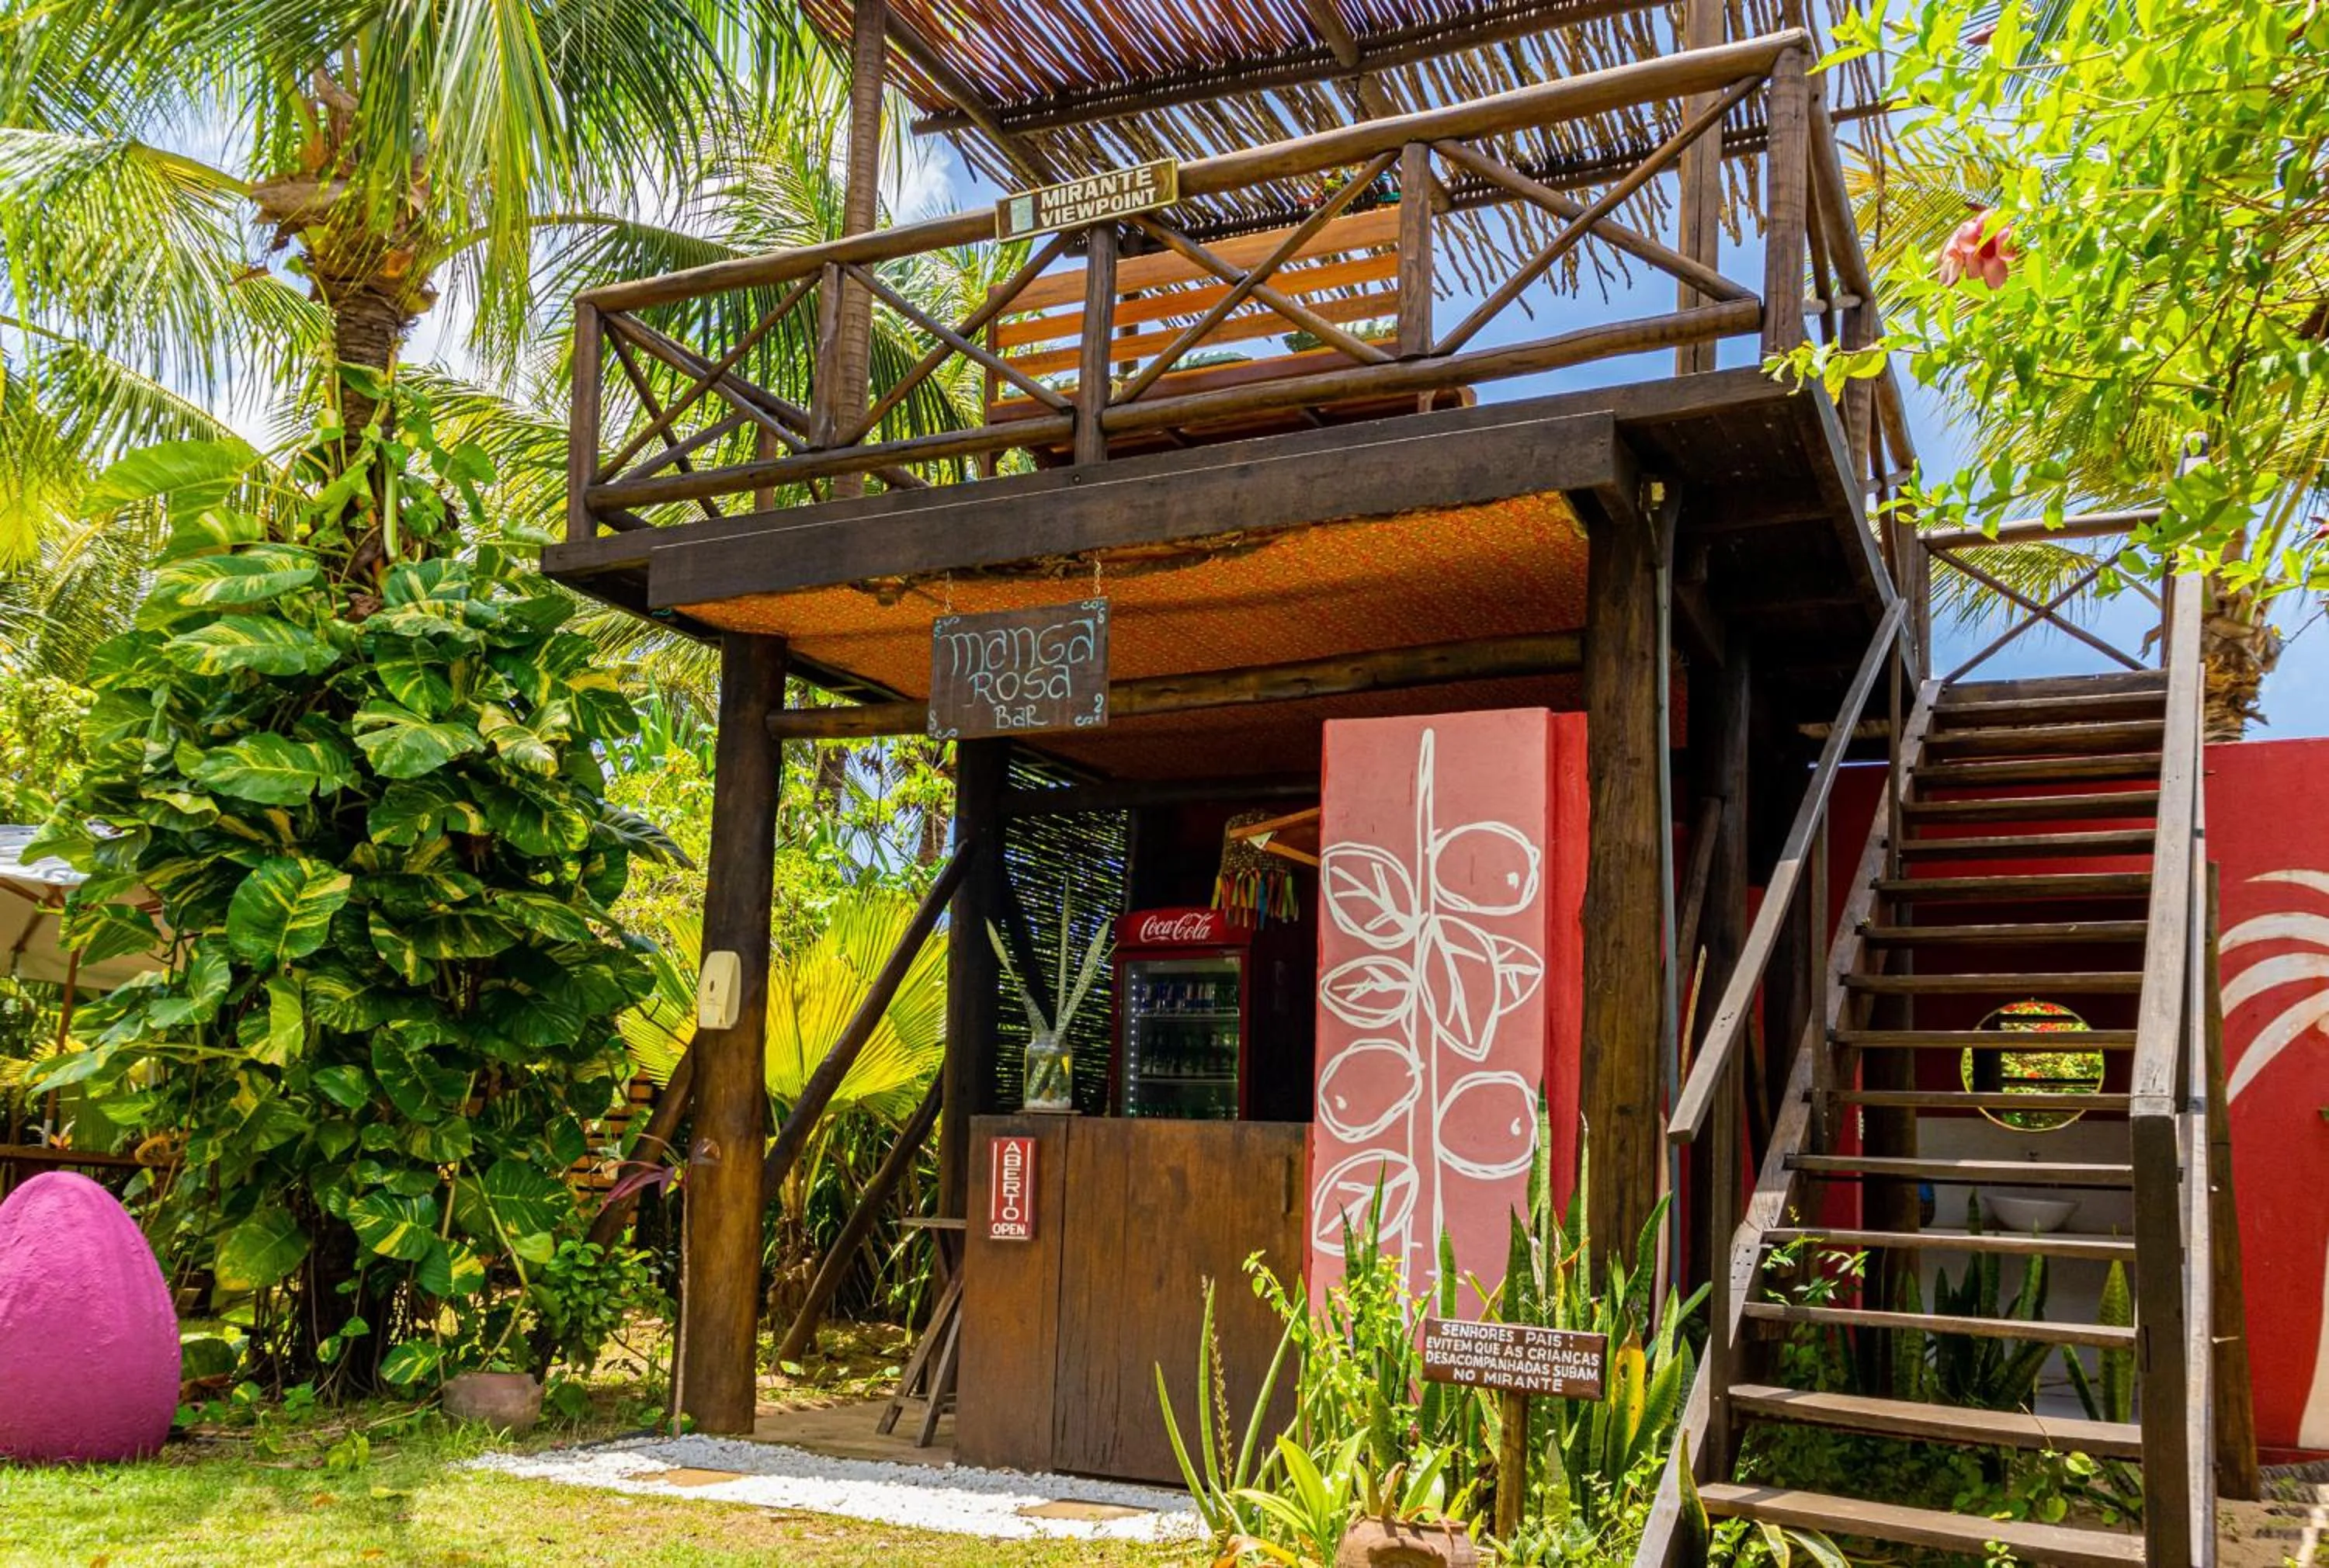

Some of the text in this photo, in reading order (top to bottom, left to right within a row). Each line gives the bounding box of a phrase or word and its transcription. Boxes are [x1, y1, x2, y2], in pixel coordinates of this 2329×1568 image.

[1041, 167, 1153, 209] MIRANTE
[1040, 188, 1156, 227] VIEWPOINT
[1140, 912, 1216, 943] Coca-Cola
[1001, 1141, 1022, 1221] ABERTO
[992, 1223, 1026, 1235] OPEN
[1426, 1336, 1472, 1352] EVITEM
[1474, 1341, 1501, 1357] QUE
[1503, 1344, 1523, 1358] AS
[1441, 1323, 1514, 1343] SENHORES
[1525, 1331, 1562, 1348] PAIS
[1426, 1351, 1598, 1381] DESACOMPANHADAS SUBAM
[1453, 1368, 1563, 1392] NO MIRANTE
